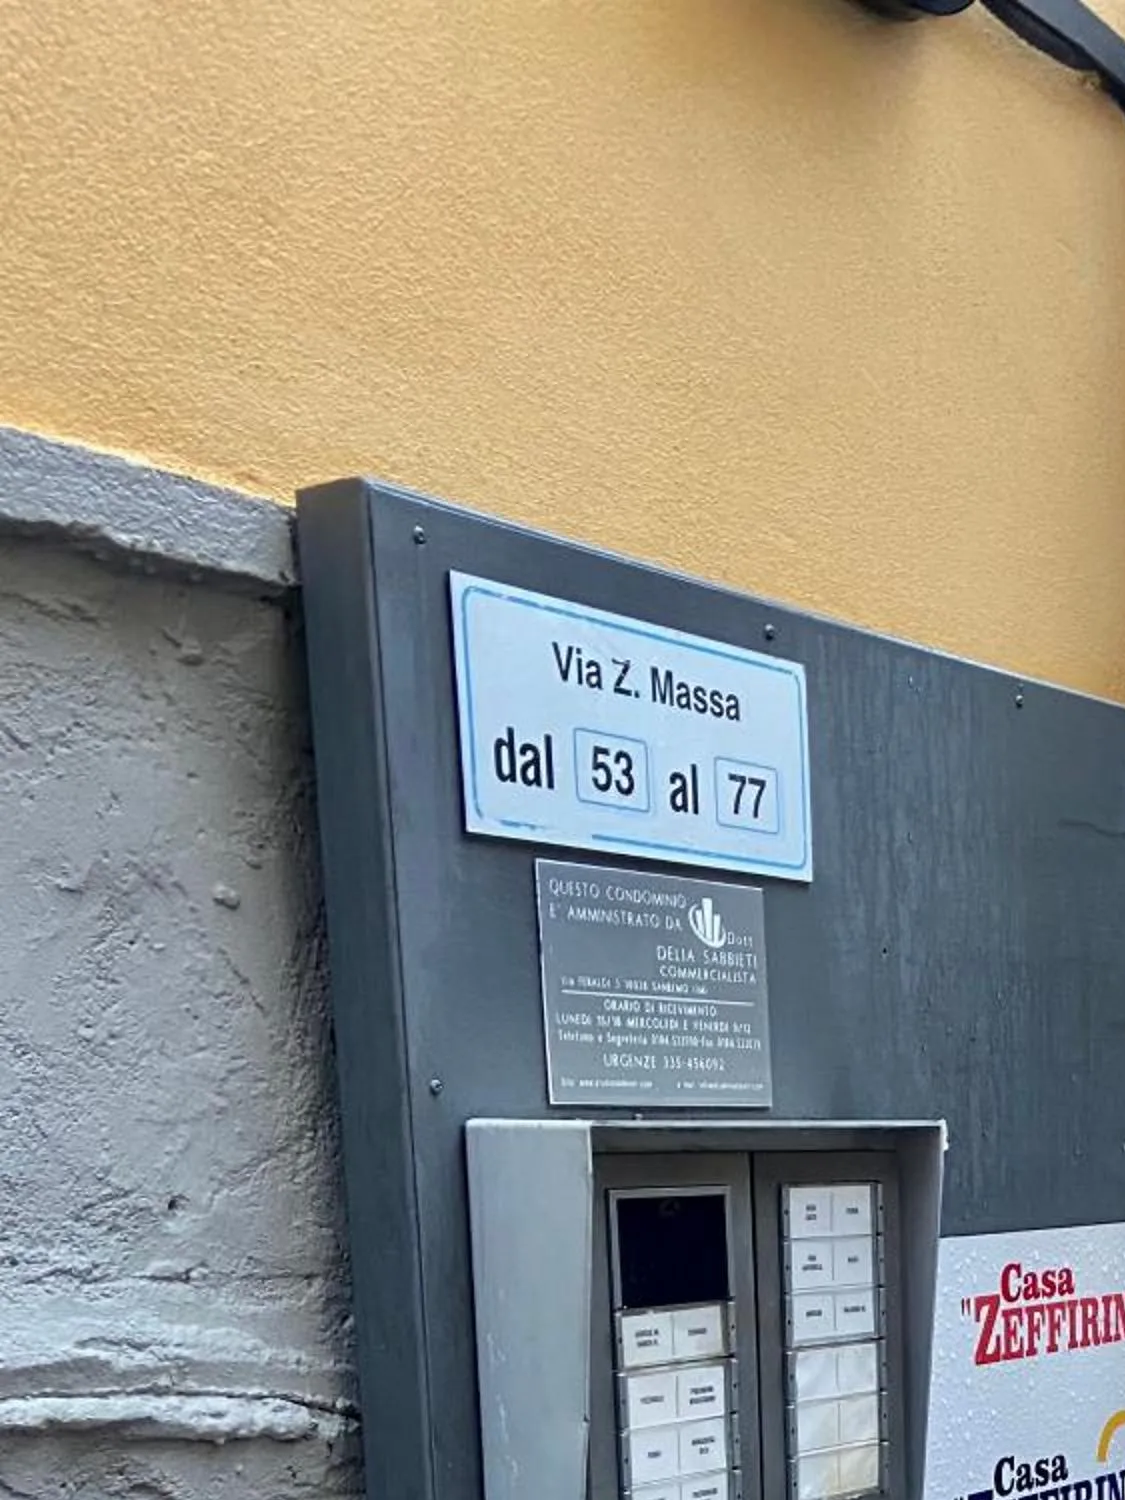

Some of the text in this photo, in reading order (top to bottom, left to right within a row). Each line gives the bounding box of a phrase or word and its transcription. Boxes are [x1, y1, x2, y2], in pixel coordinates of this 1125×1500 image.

[552, 641, 741, 721] Via Z. Massa
[493, 726, 767, 818] dal 53 al 77
[549, 877, 687, 909] QUESTO CONDOMINIO
[567, 904, 660, 929] AMMINISTRATO
[665, 915, 683, 931] DA
[659, 964, 757, 985] COMMERCIALISTA
[703, 949, 757, 970] SABBIETI
[603, 1053, 656, 1070] URGENZE
[1000, 1262, 1075, 1303] Casa
[993, 1453, 1069, 1498] Casa
